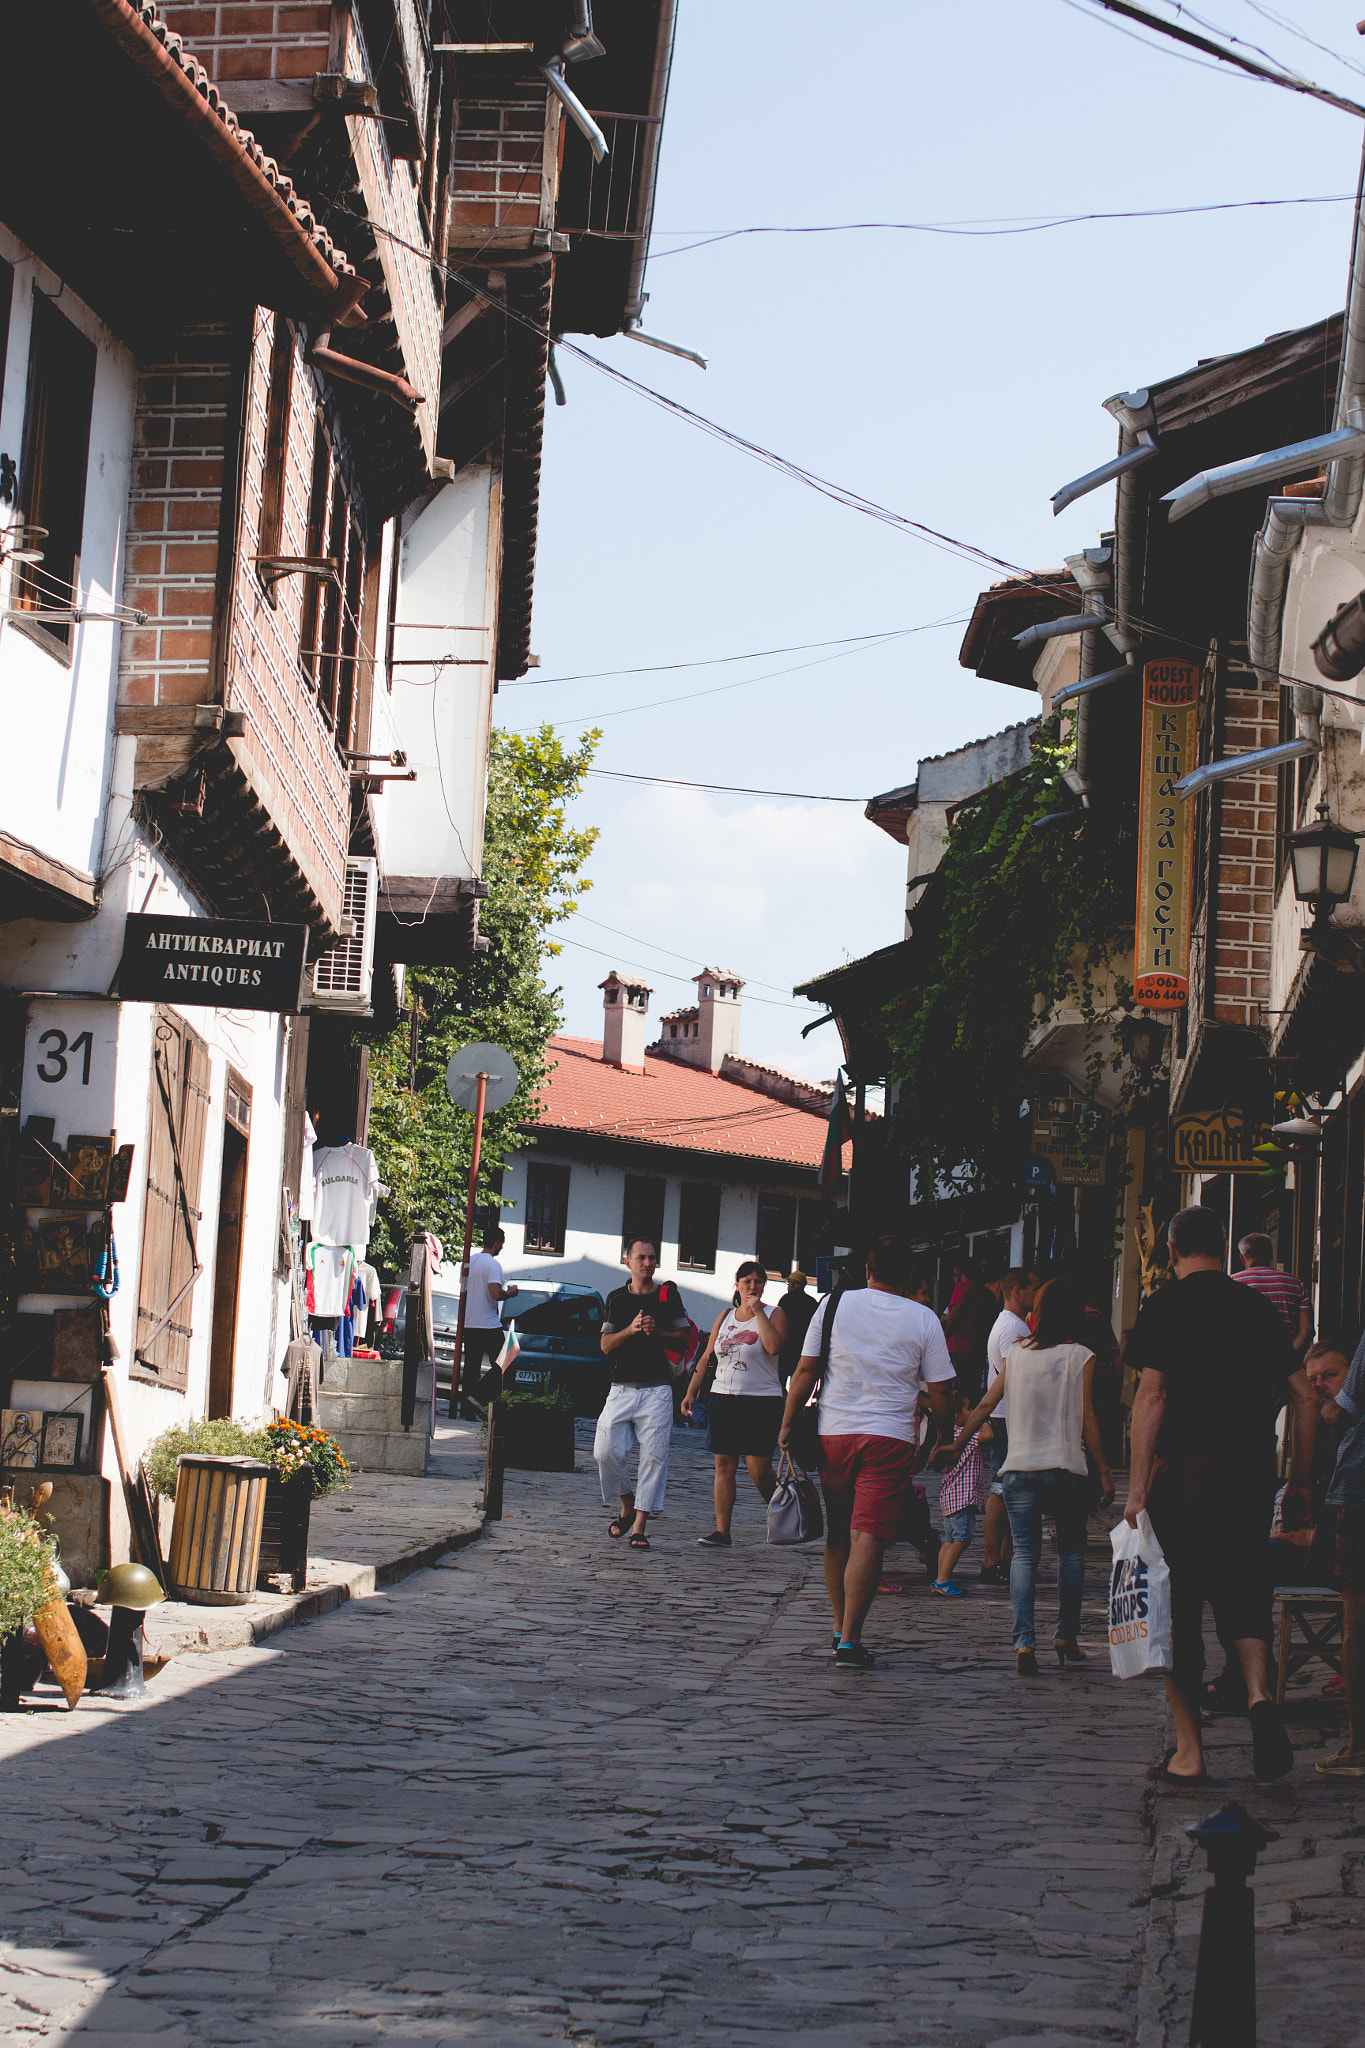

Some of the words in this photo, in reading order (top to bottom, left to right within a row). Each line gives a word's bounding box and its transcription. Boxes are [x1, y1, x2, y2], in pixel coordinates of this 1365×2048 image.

[1149, 666, 1193, 684] GUEST
[1148, 685, 1193, 703] HOUSE
[145, 932, 285, 959] АНТИКВАРИАТ
[163, 963, 262, 987] ANTIQUES
[1156, 977, 1179, 988] 062
[1138, 988, 1160, 1000] 606
[1163, 989, 1186, 1001] 440
[37, 1029, 94, 1085] 31
[320, 1175, 359, 1187] BULGARIA
[1032, 1166, 1040, 1178] P
[1111, 1591, 1149, 1626] SHOPS
